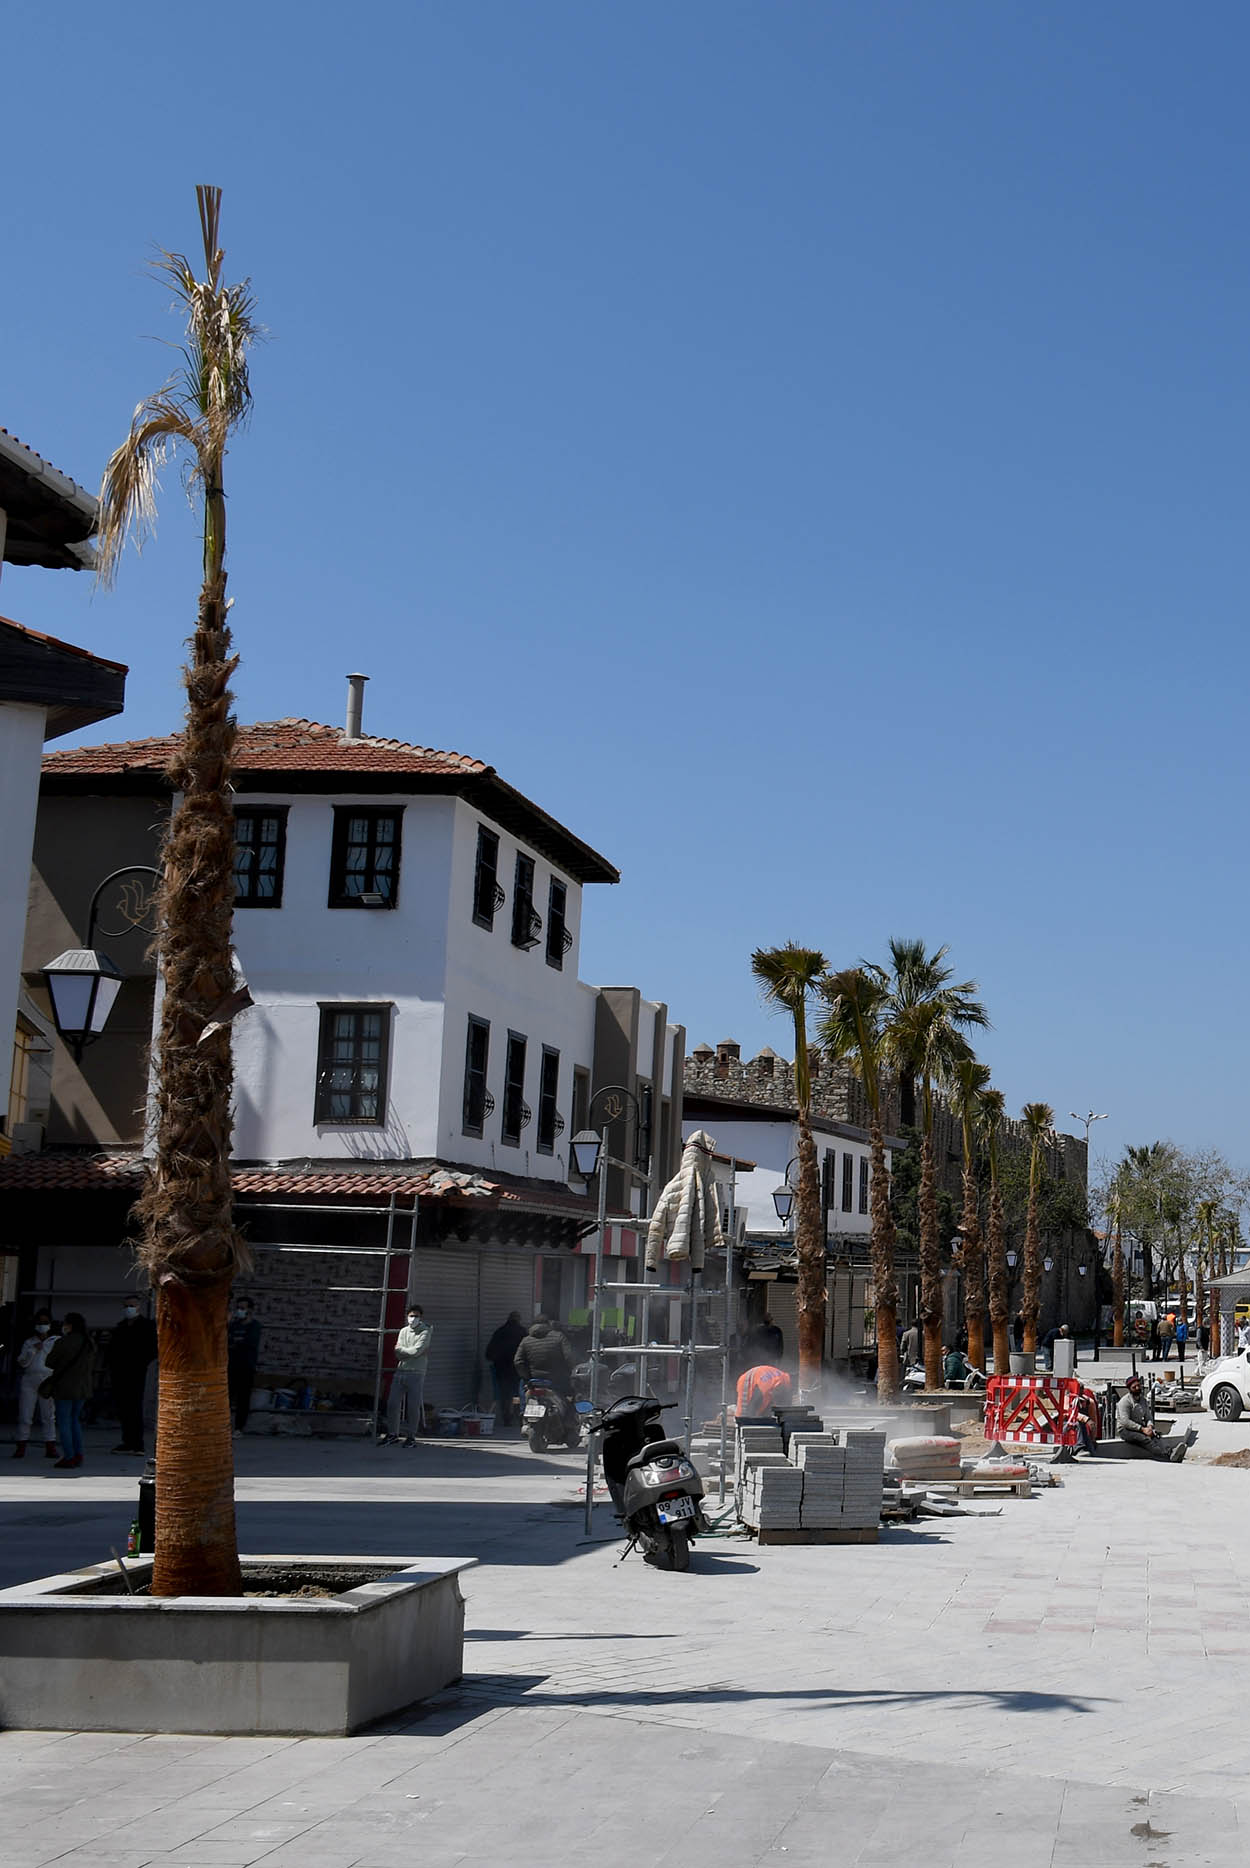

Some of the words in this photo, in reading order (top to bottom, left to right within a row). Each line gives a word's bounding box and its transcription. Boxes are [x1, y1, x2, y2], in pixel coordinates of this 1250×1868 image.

[658, 1502, 670, 1512] 09
[680, 1497, 690, 1507] JV
[675, 1507, 692, 1518] 911
